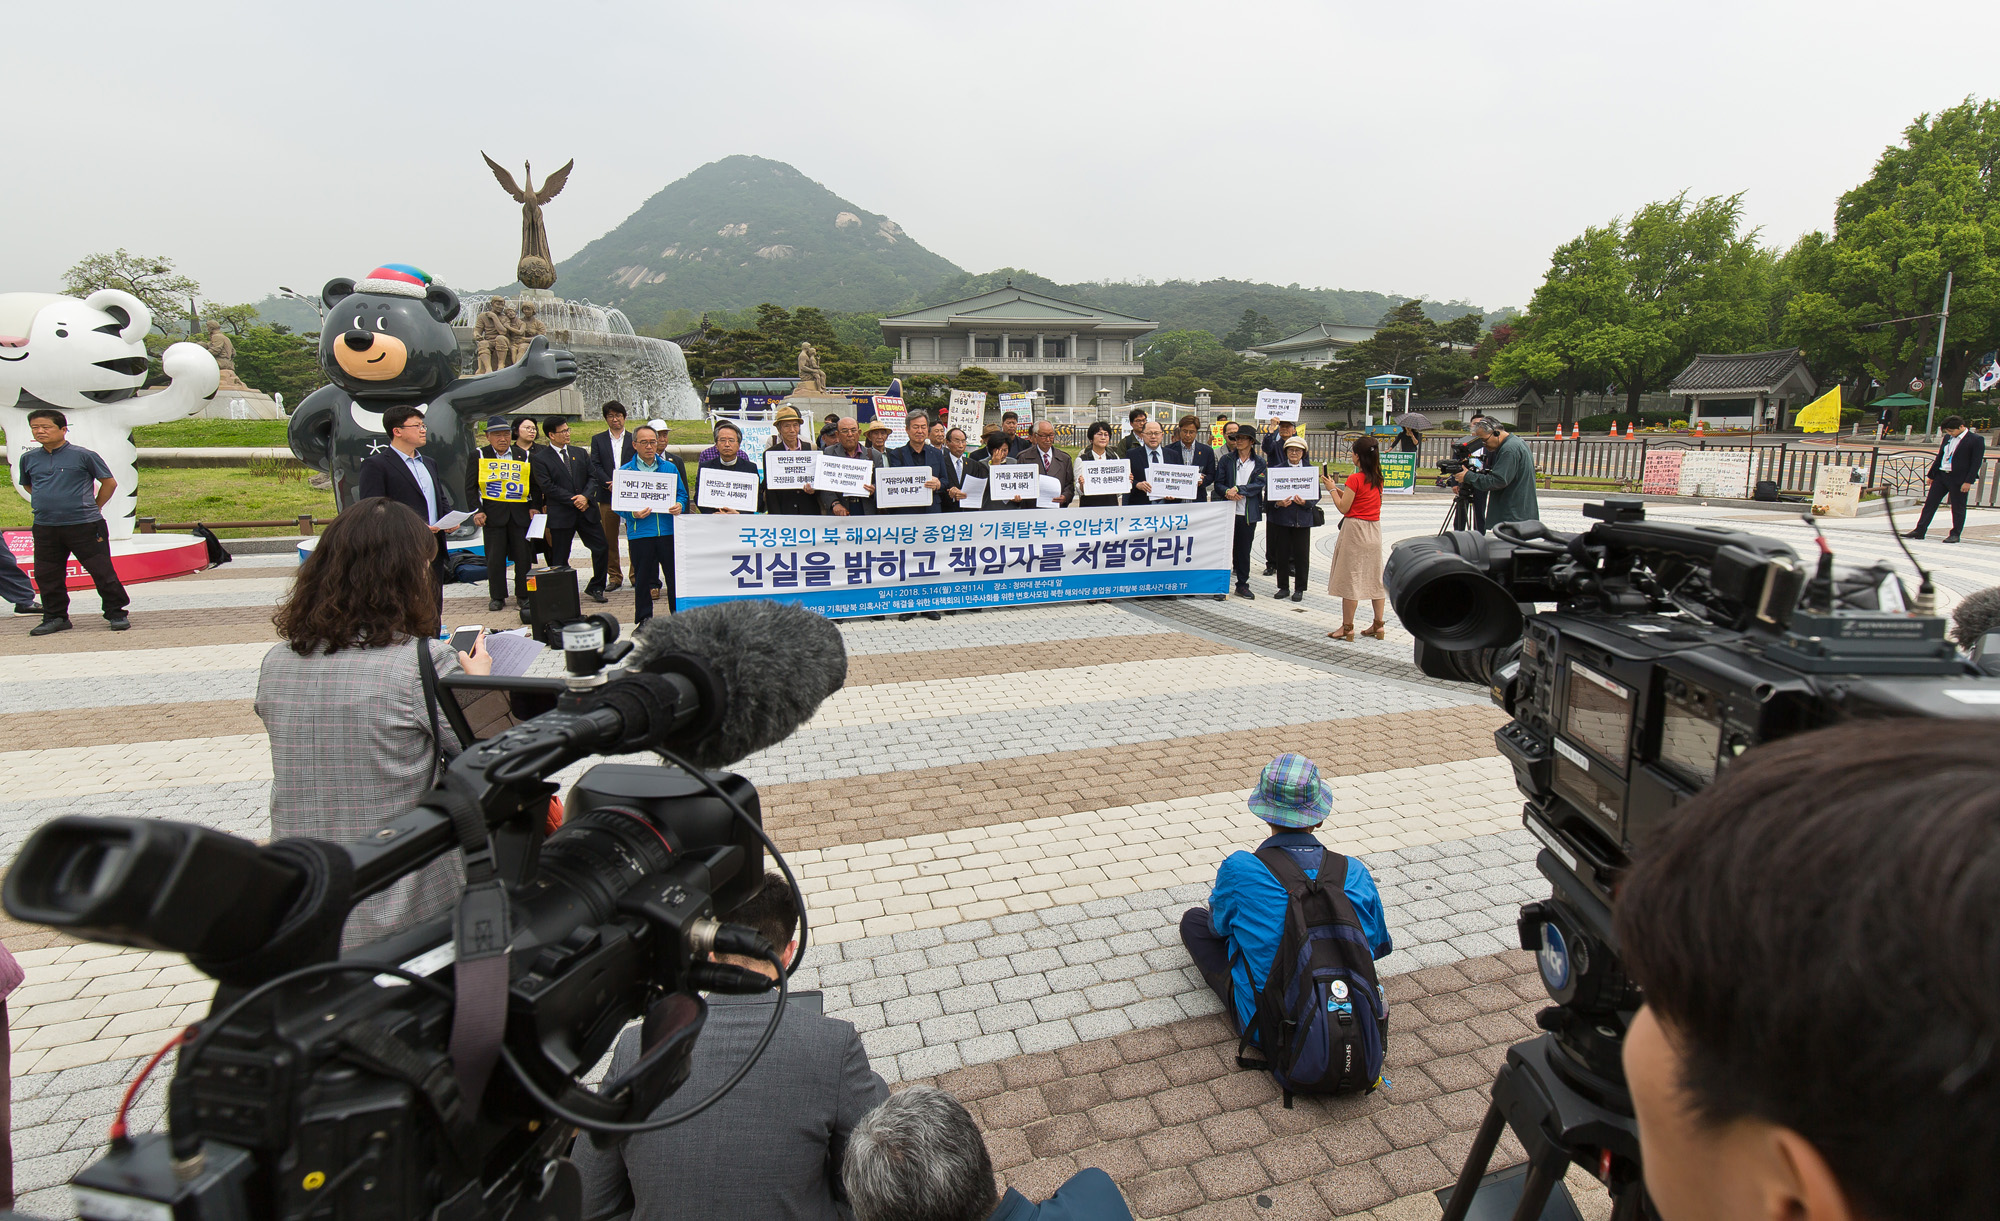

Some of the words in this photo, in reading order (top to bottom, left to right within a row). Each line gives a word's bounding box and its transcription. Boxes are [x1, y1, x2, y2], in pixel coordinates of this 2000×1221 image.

[488, 462, 521, 472] 우리의
[488, 472, 520, 481] 소원은
[486, 481, 524, 500] 통일
[641, 481, 654, 489] 가는
[656, 482, 668, 490] 줄도
[710, 490, 725, 498] 정부는
[727, 491, 747, 499] 사과하라
[739, 527, 816, 548] 국정원의
[822, 528, 841, 545] 북
[845, 526, 918, 545] 해외식당
[922, 524, 973, 544] 종업원
[1128, 514, 1188, 533] 조작사건
[730, 551, 836, 588] 진실을
[844, 549, 940, 585] 밝히고
[948, 543, 1066, 576] 책임자를
[1072, 536, 1194, 570] 처벌하라!
[827, 603, 857, 613] 기획탈북
[893, 600, 914, 609] 해결을
[916, 598, 930, 608] 위한
[932, 596, 960, 606] 대책회의
[965, 594, 999, 604] 민주사회를
[1016, 590, 1049, 600] 변호사모임
[1065, 588, 1091, 596] 해외식당
[1092, 586, 1111, 595] 종업원
[1112, 585, 1137, 593] 기획탈북
[1139, 584, 1163, 592] 의혹사건
[879, 590, 893, 599] 일시
[922, 586, 952, 595] 5.14(월)
[954, 584, 984, 593] 오전11시
[1013, 581, 1033, 590] 청와대
[1034, 580, 1054, 588] 분수대
